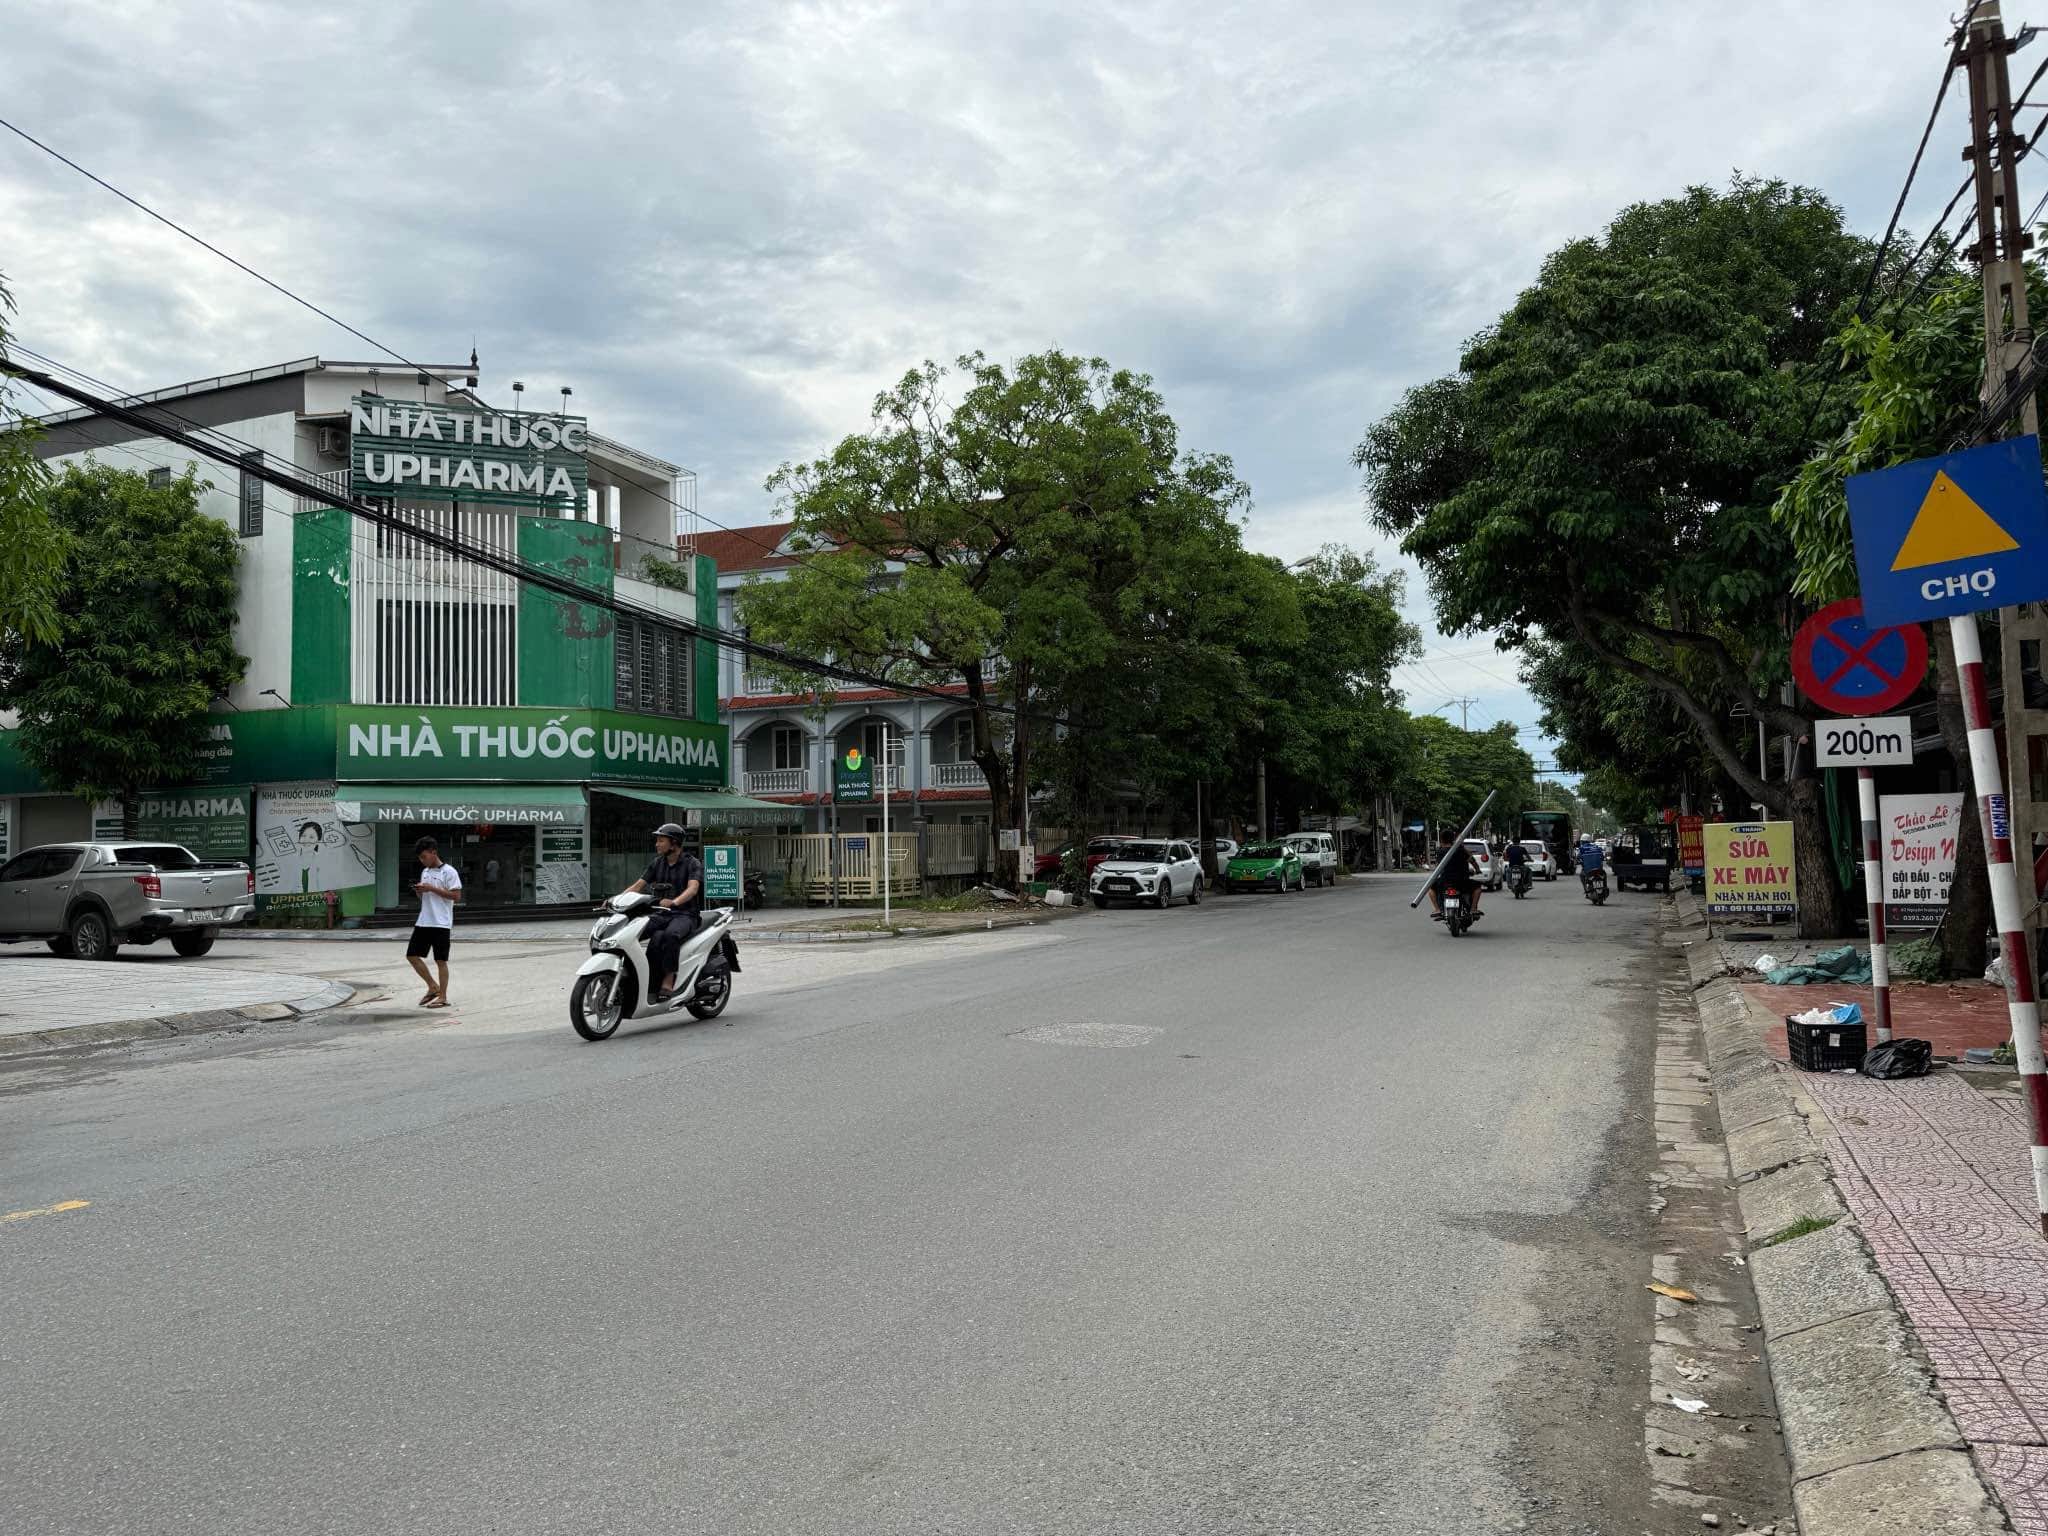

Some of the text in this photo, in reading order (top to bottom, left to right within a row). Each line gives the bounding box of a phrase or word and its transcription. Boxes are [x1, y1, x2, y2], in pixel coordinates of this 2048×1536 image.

[364, 453, 577, 497] UPHARMA
[1921, 567, 1997, 601] CHỢ
[349, 715, 720, 768] NHÀ THUỐC UPHARMA
[1826, 729, 1902, 757] 200m
[378, 804, 565, 822] NHÀ THUỐC UPHARMA
[1729, 835, 1770, 858] SỬA
[1891, 838, 1936, 866] Design
[1713, 863, 1789, 884] XE MÁY
[1715, 889, 1791, 904] NHẬN HÀN HƠI
